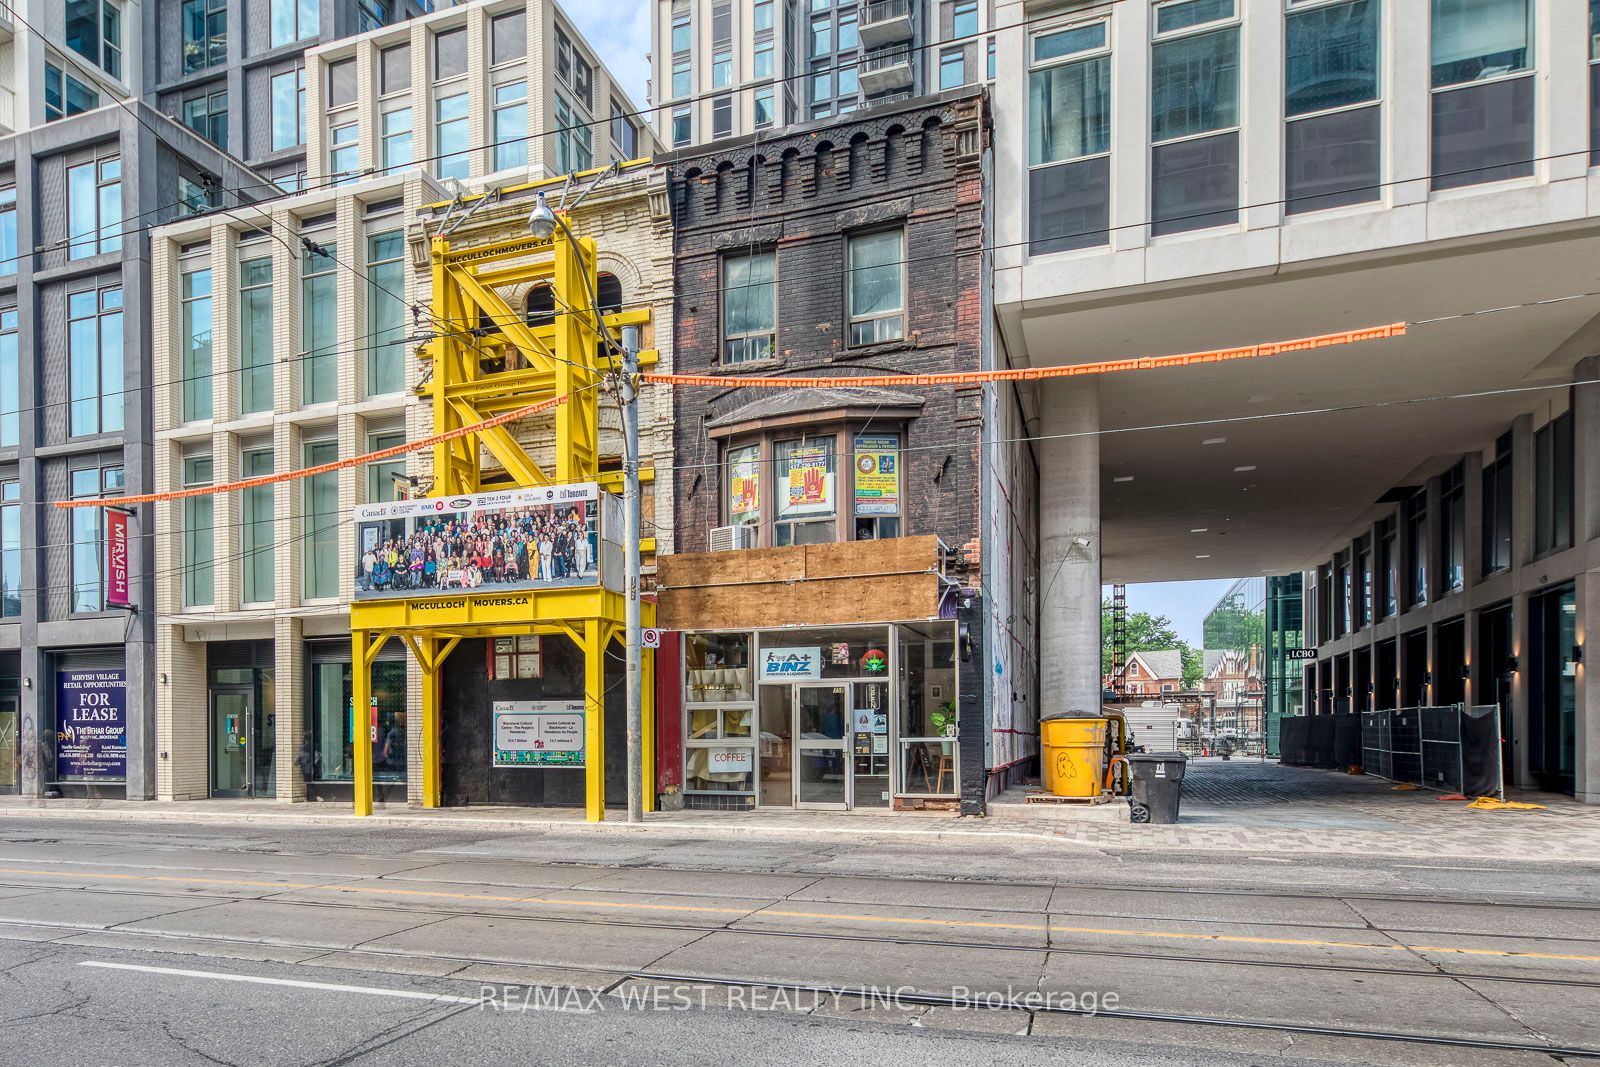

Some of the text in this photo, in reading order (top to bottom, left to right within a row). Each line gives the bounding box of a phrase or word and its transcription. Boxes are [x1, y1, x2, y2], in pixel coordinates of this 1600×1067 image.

[449, 238, 554, 264] MCCULLOCHMOVERS.CA
[567, 489, 588, 498] TORONTO
[361, 507, 387, 518] Canada
[115, 523, 125, 593] MIRVISH
[411, 597, 529, 610] MCCULLOCH MOVERS.CA
[786, 653, 812, 661] A+
[1291, 650, 1314, 658] LCBO
[766, 661, 812, 673] BINZ
[79, 692, 110, 706] FOR
[72, 707, 118, 721] LEASE
[75, 726, 87, 735] THE
[86, 726, 105, 735] BEHAR
[714, 753, 747, 762] COFFEE
